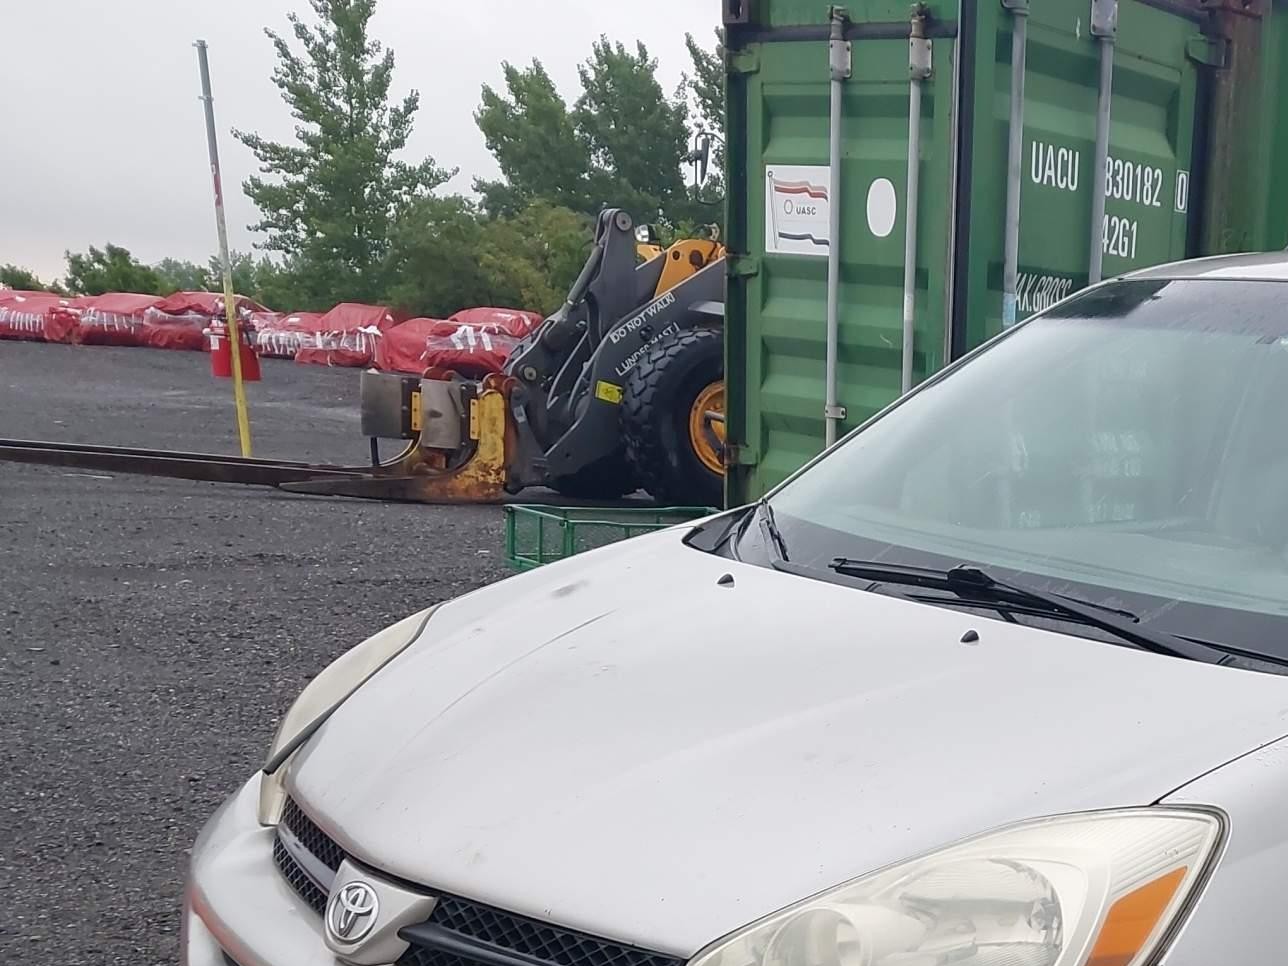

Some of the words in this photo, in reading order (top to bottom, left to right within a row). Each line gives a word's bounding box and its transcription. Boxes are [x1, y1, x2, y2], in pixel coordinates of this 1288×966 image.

[1031, 141, 1079, 191] UACU
[1104, 156, 1163, 207] 830182
[1176, 172, 1187, 210] 0
[796, 206, 817, 216] UASC
[1101, 214, 1138, 259] 42G1
[610, 327, 626, 344] DO
[626, 311, 647, 332] NOT
